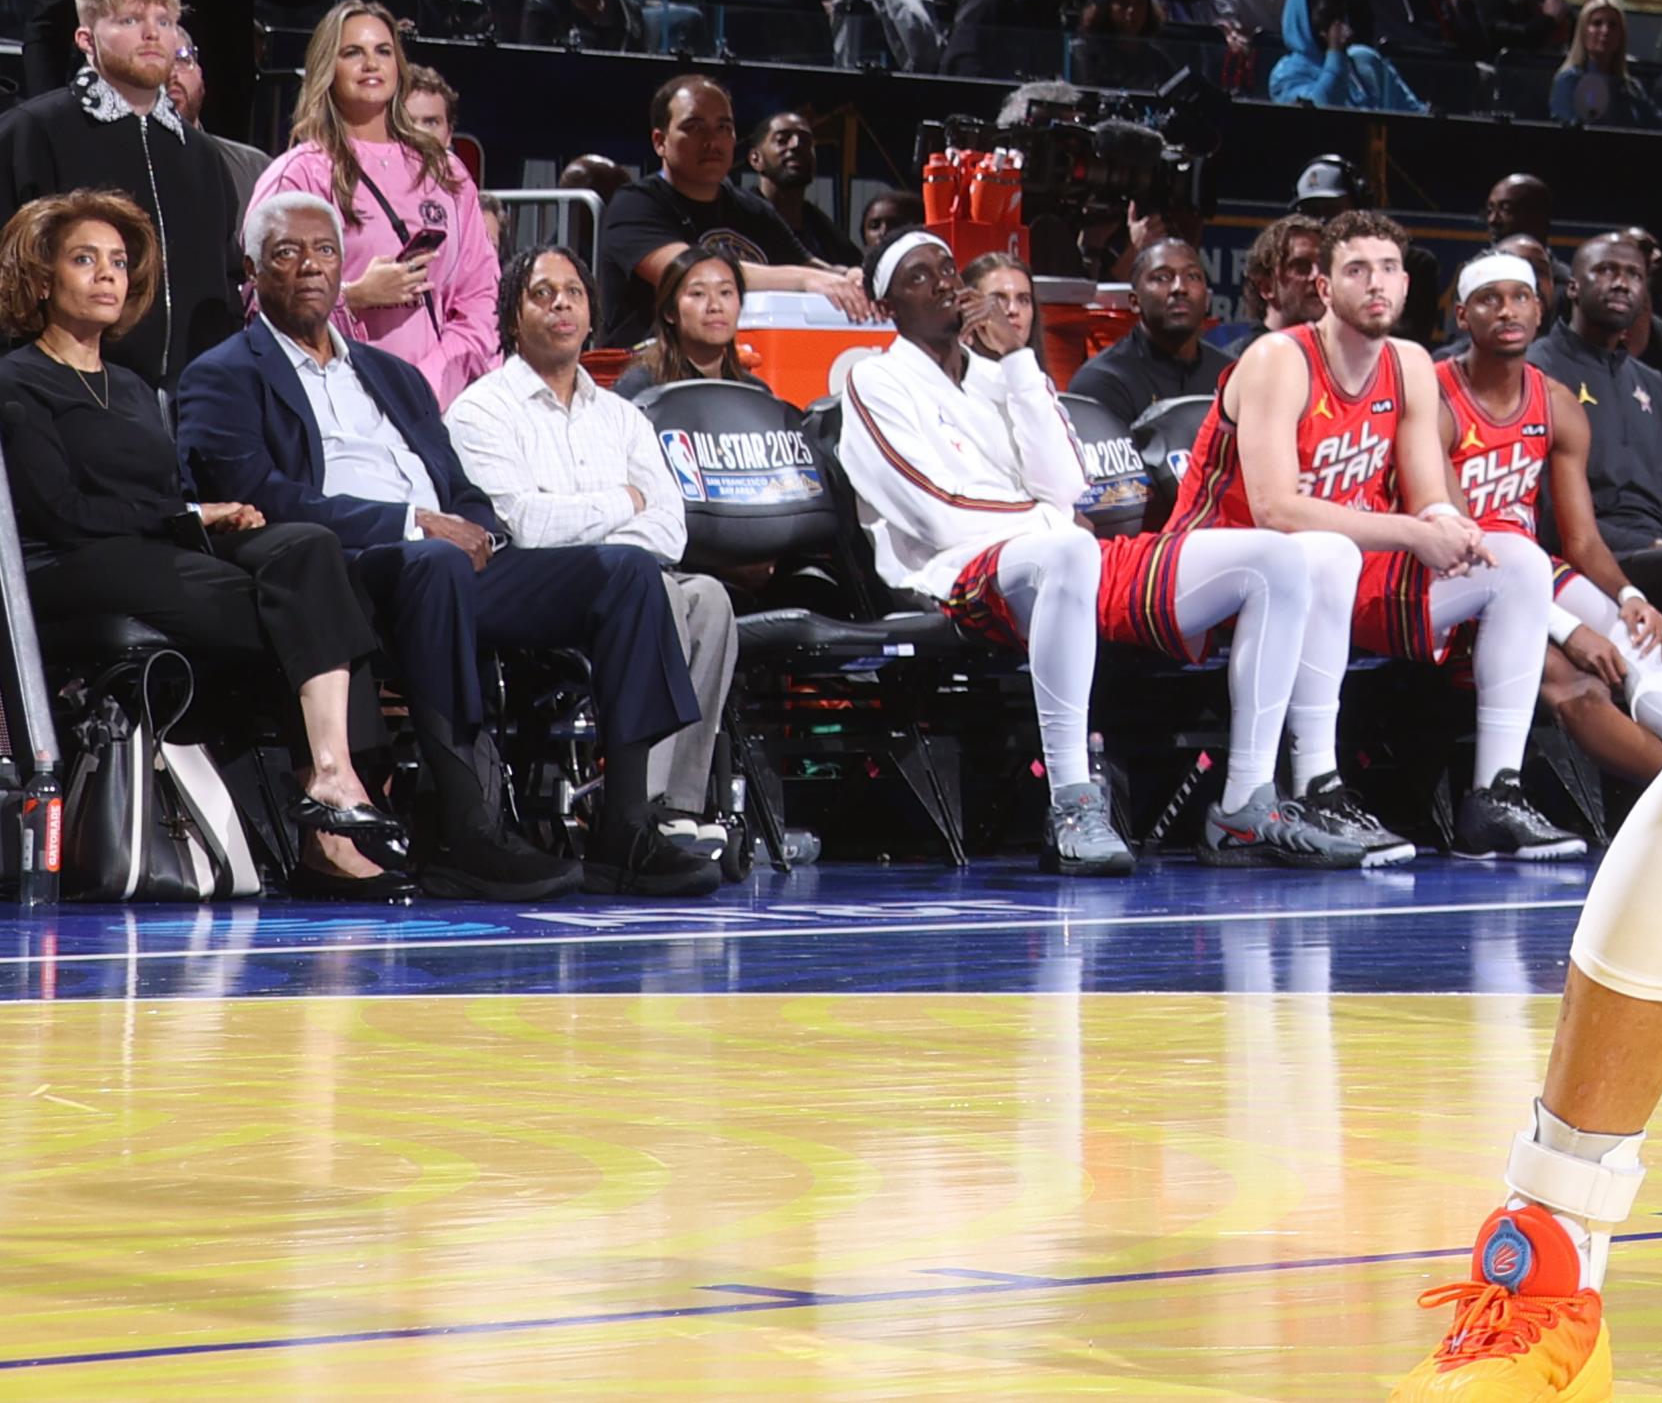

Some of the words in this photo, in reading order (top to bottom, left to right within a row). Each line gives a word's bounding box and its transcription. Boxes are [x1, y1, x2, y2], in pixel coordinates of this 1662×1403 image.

[766, 430, 814, 468] 2025
[1100, 436, 1144, 476] 2025
[1313, 420, 1379, 468] ALL
[1460, 441, 1531, 490] ALL
[1469, 457, 1544, 518] TAR
